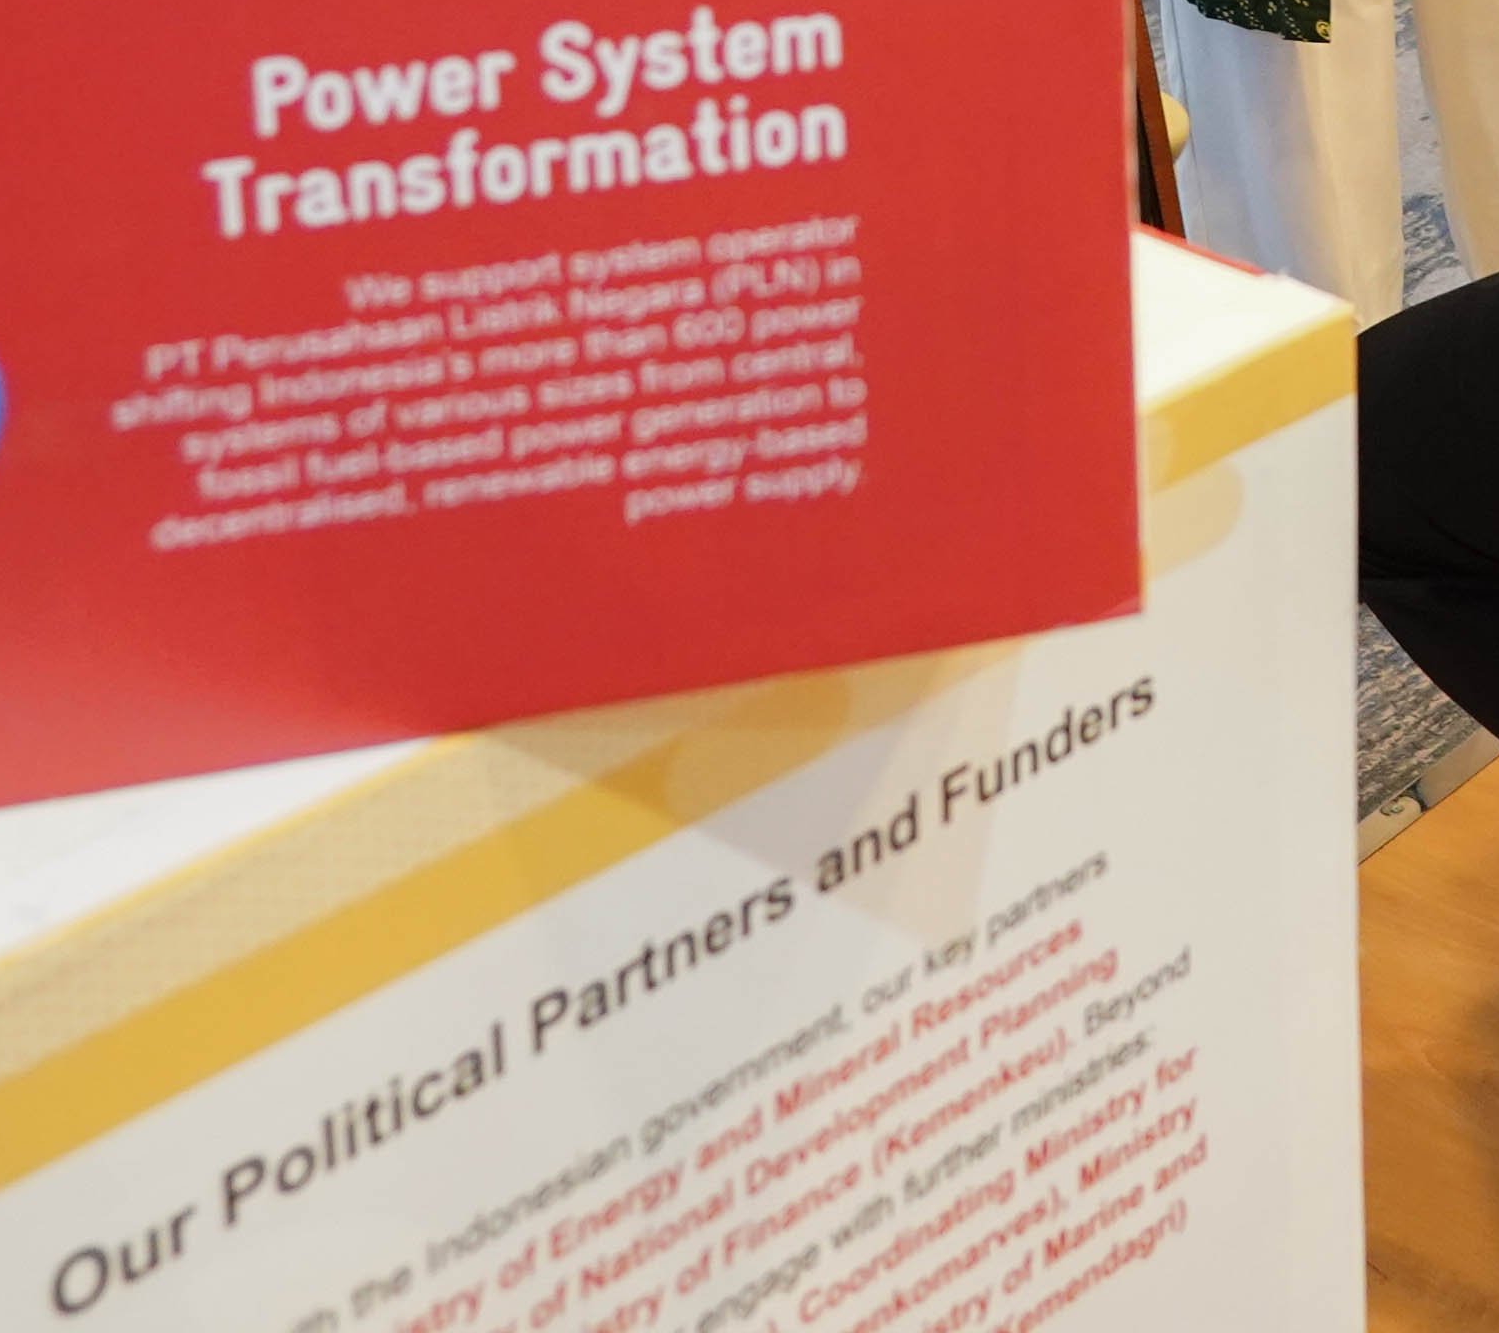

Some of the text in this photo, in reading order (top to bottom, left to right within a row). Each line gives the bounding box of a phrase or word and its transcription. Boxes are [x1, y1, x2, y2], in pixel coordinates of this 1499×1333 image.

[202, 95, 845, 237] Transformation
[252, 6, 842, 137] Power System
[50, 677, 1153, 1317] Our Political Partners and Funders
[549, 920, 1082, 1259] Energy and Mineral Resources
